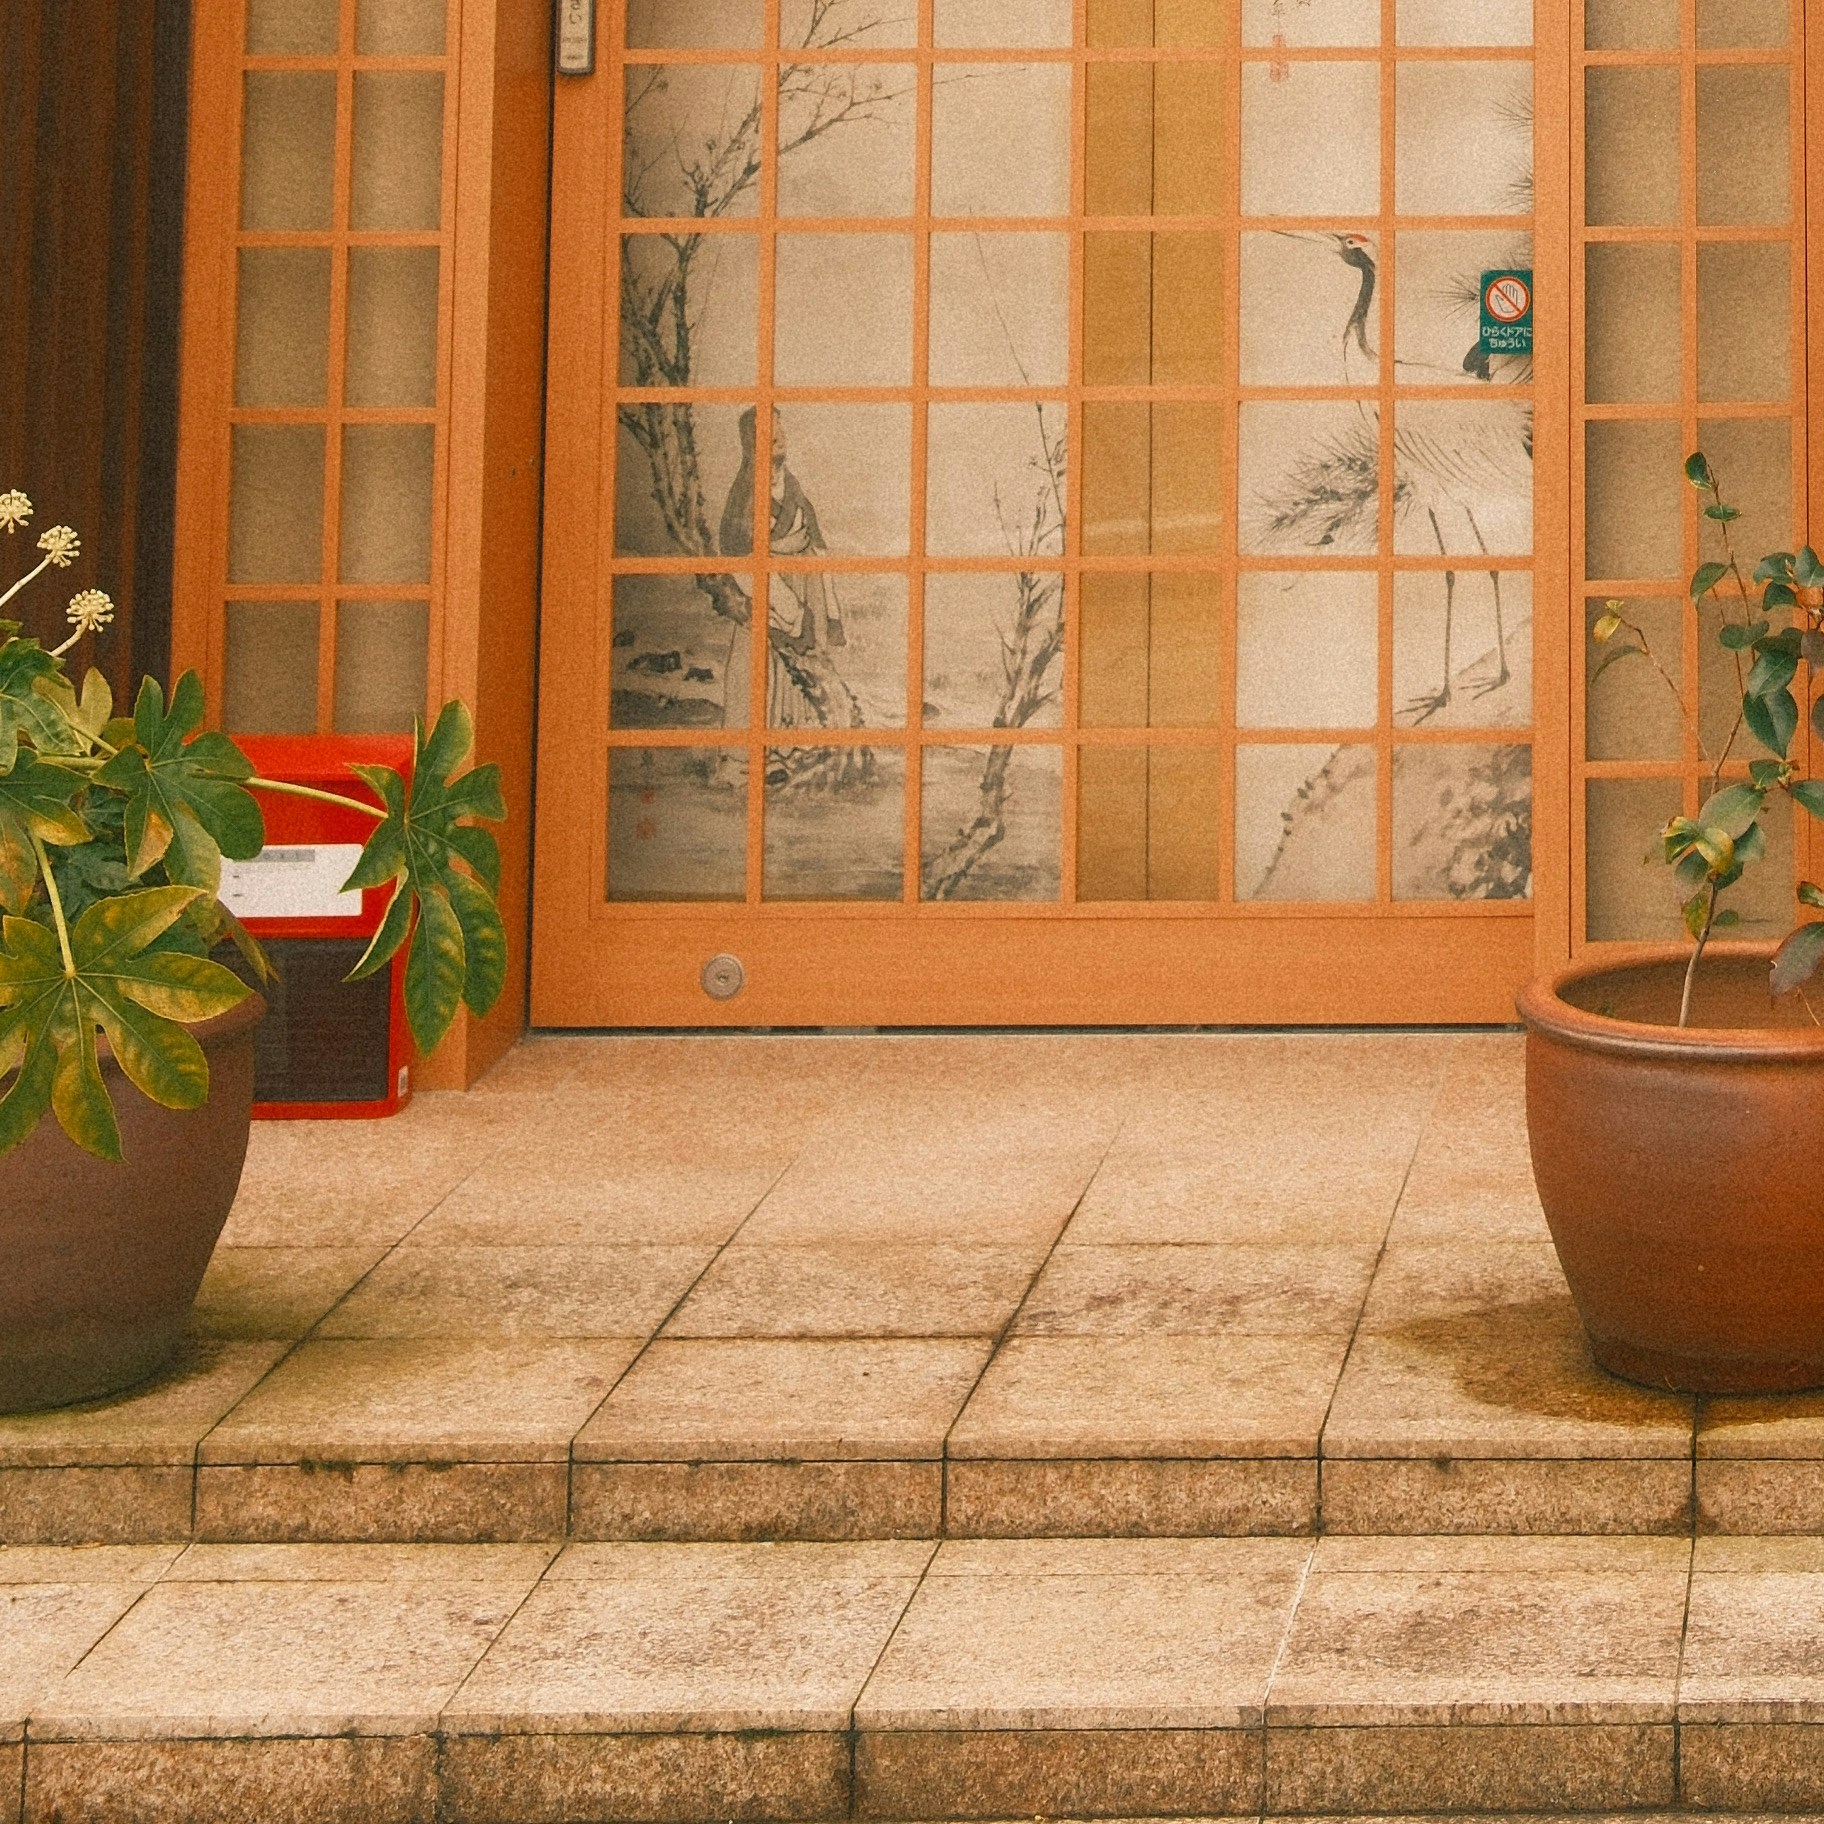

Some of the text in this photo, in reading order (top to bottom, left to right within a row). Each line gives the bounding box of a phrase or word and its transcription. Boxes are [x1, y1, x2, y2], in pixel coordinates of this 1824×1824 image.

[1482, 325, 1533, 338] ひらくドアに
[1488, 337, 1527, 349] ちゅうい
